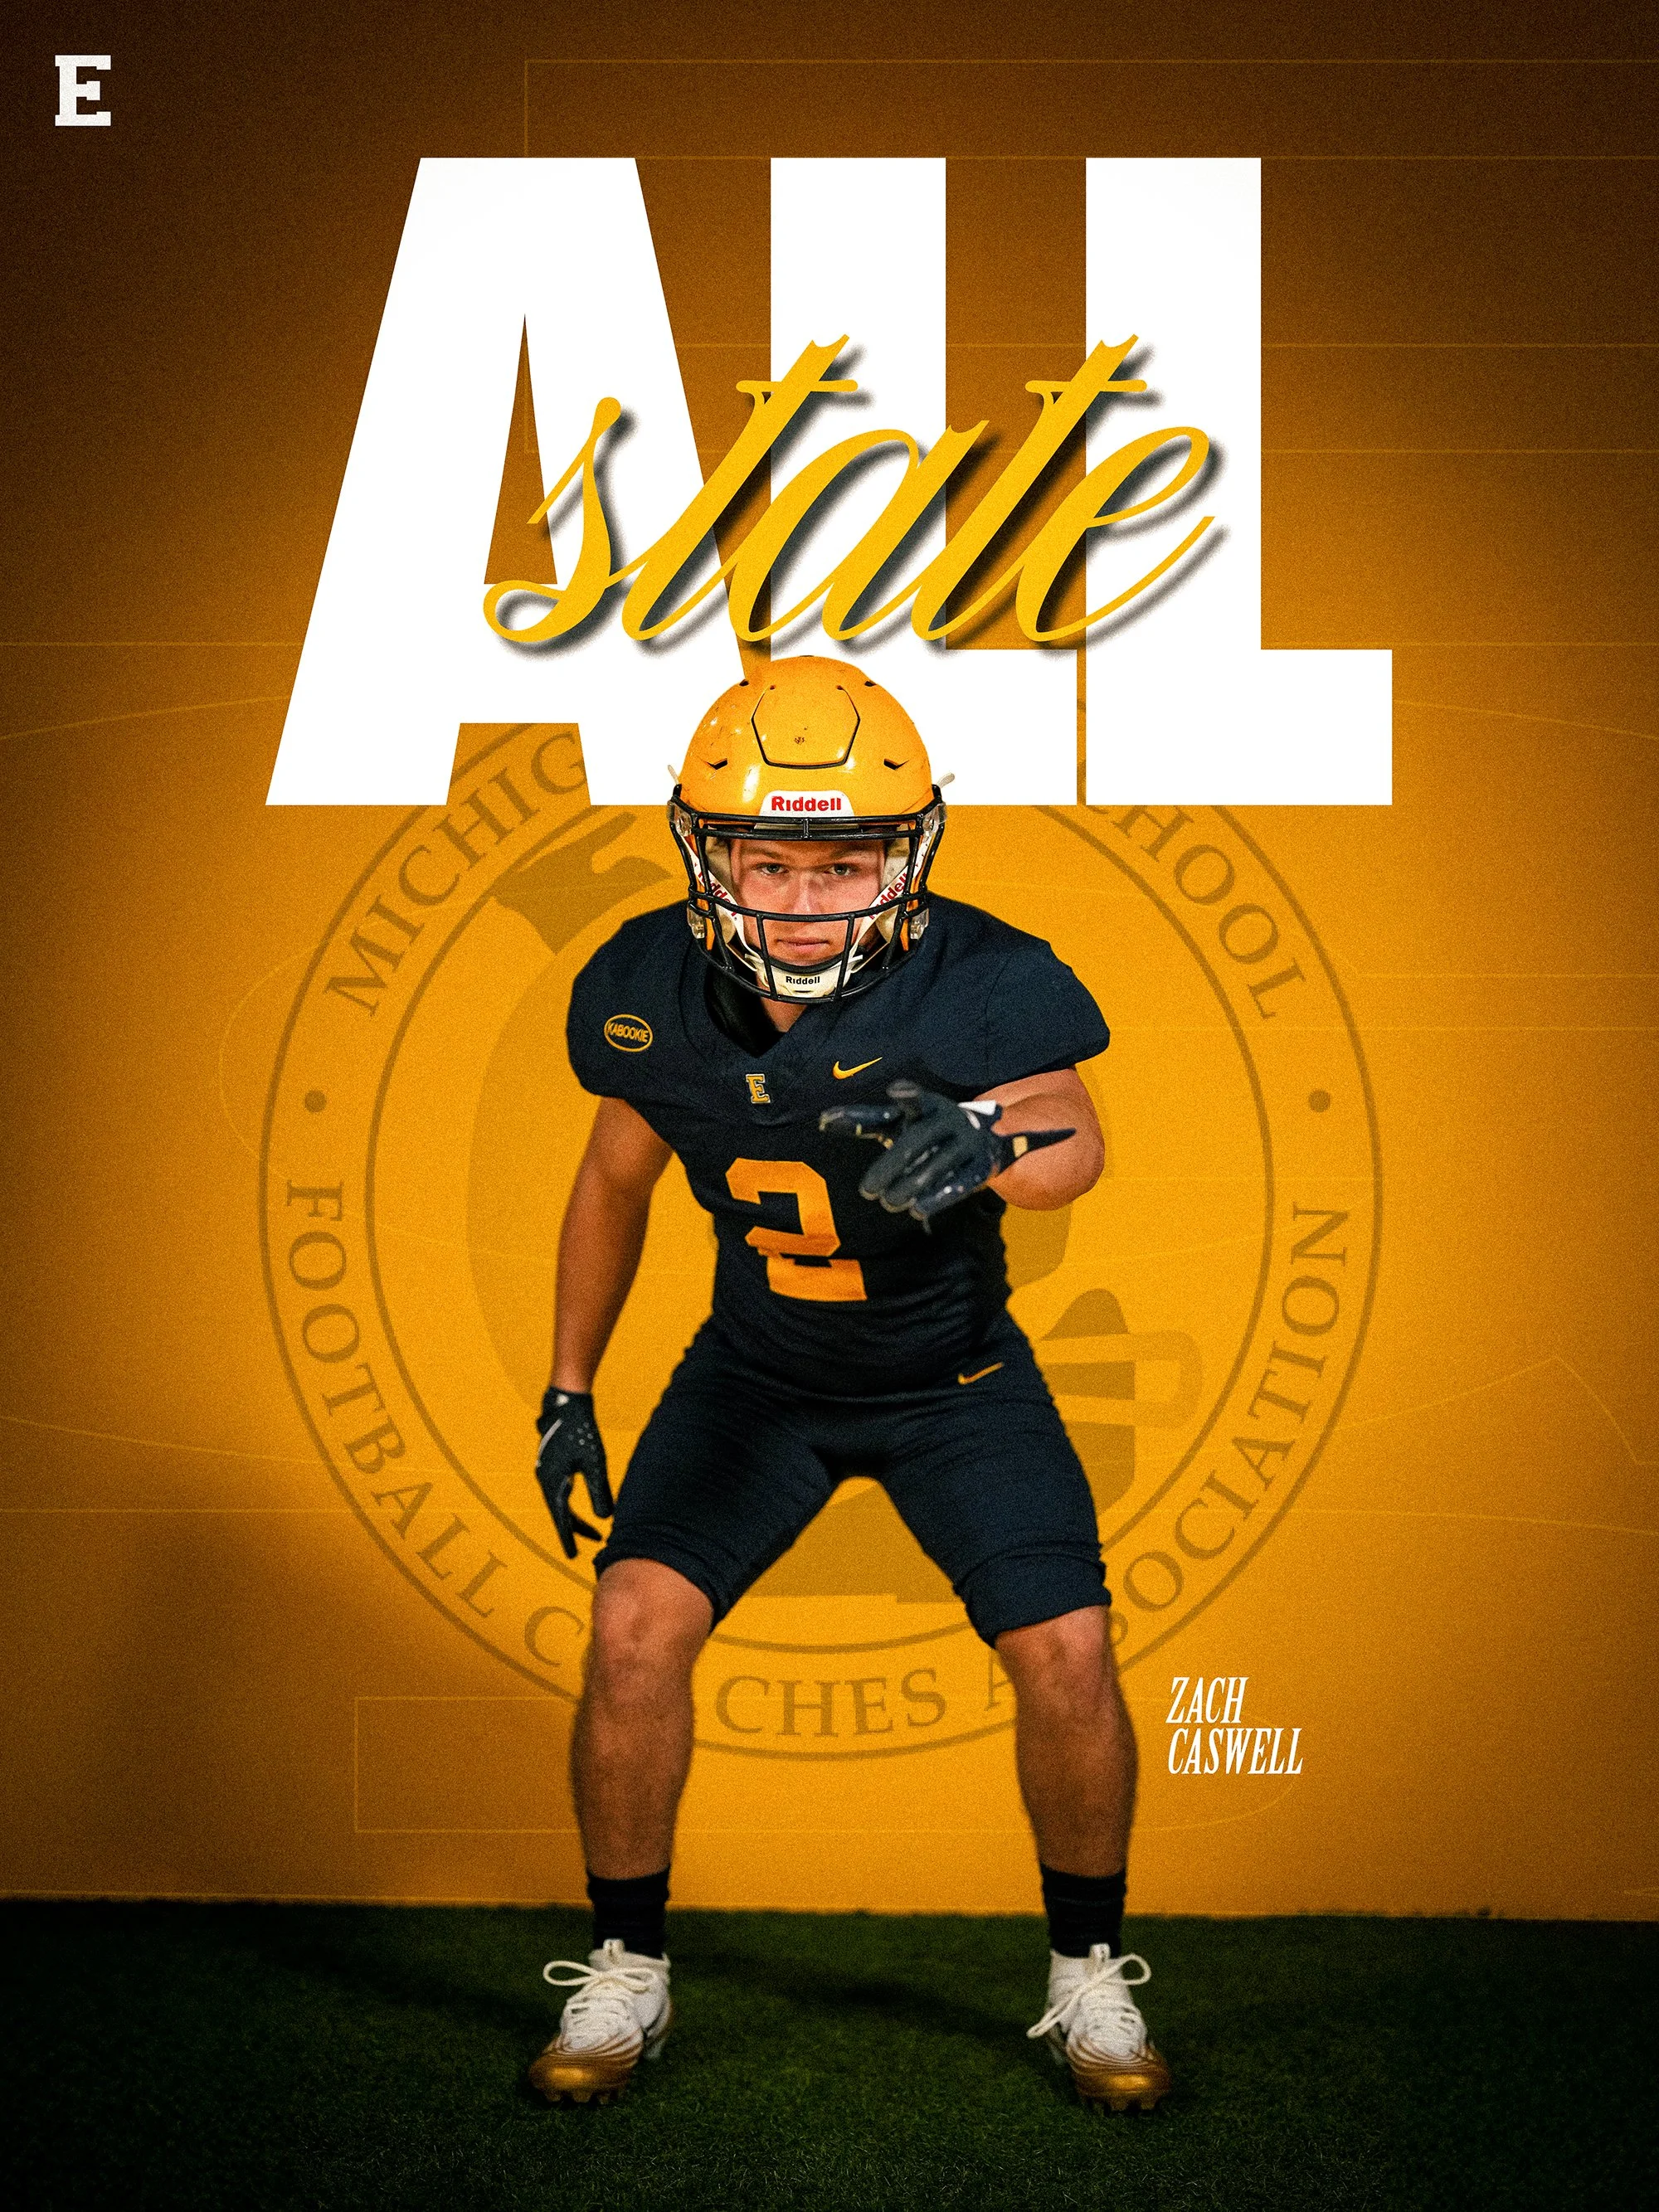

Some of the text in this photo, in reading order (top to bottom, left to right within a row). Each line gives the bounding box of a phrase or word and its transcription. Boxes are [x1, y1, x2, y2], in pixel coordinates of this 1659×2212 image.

[771, 796, 842, 811] Riddell
[786, 975, 820, 985] Riddell
[607, 1021, 649, 1043] KABOOKIE
[747, 1074, 771, 1104] E
[725, 1158, 868, 1301] 2
